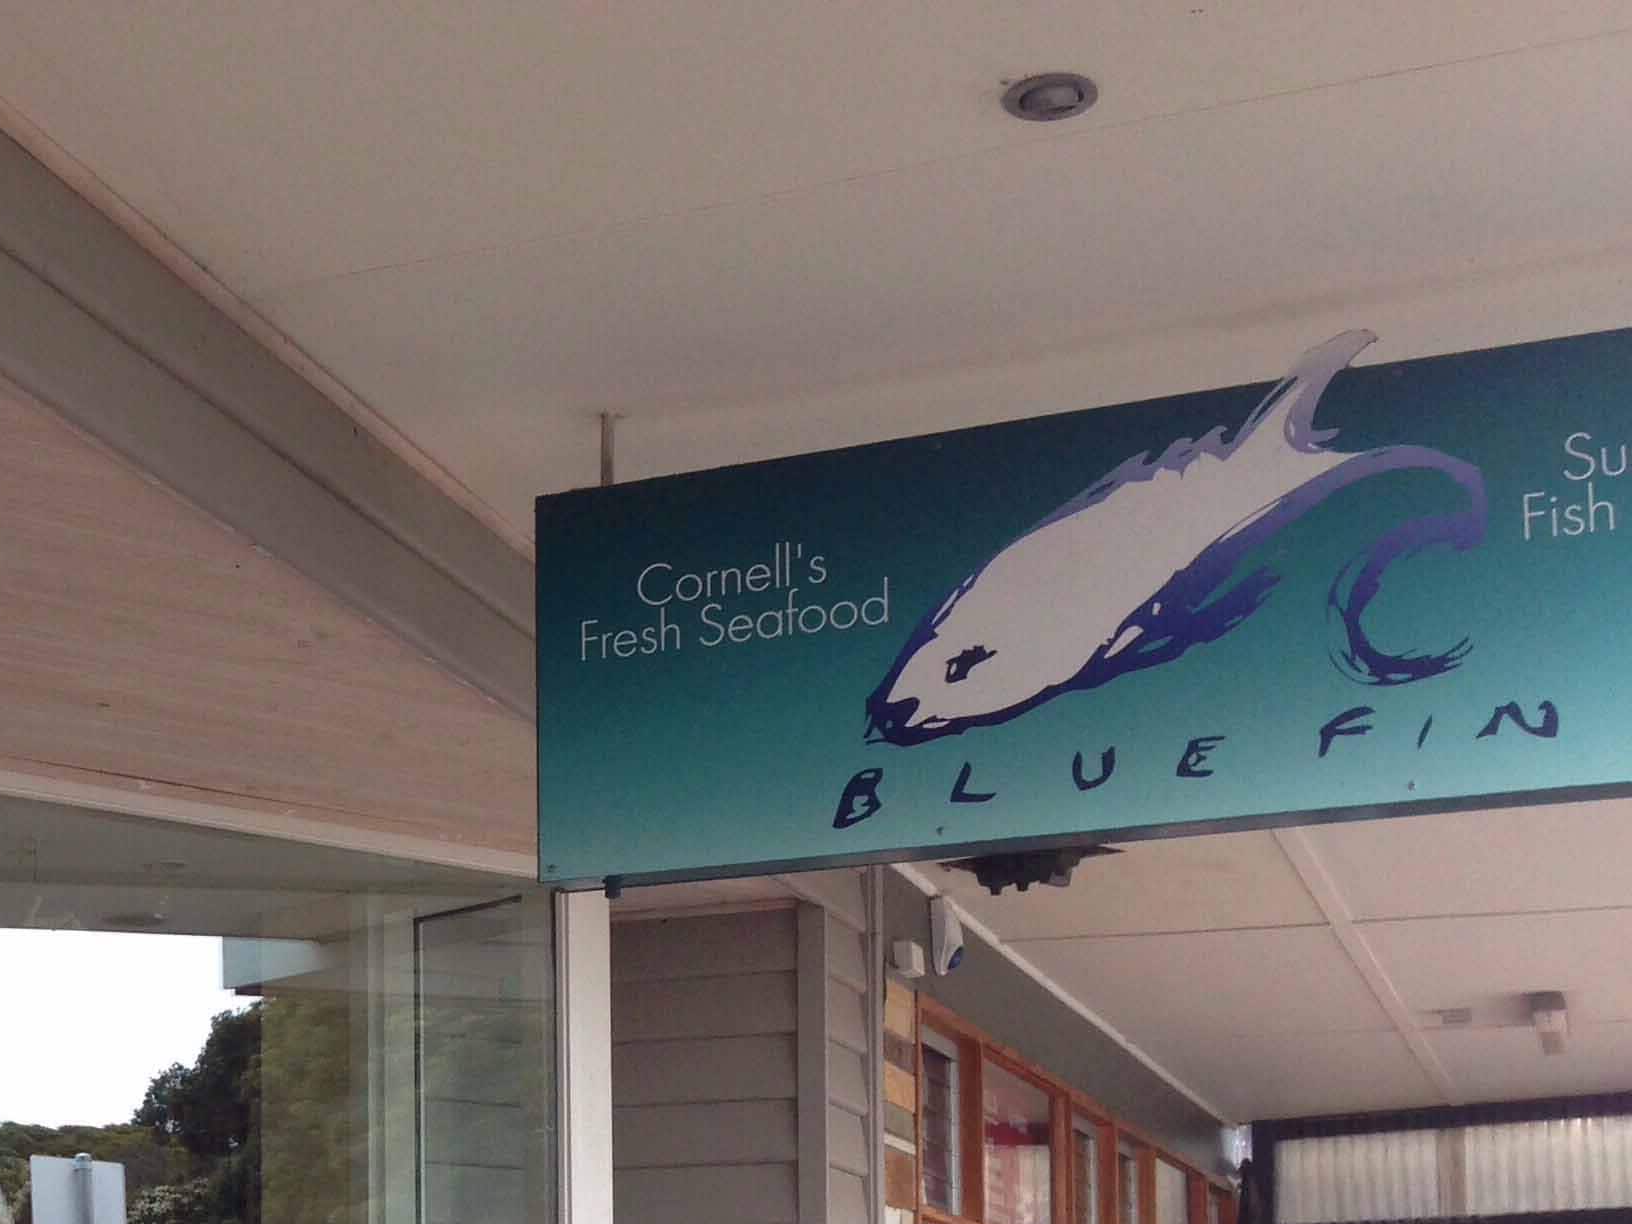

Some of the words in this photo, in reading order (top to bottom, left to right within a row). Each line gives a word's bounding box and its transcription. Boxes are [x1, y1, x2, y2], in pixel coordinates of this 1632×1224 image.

[1522, 481, 1615, 540] Fish
[637, 541, 827, 605] Cornell's
[580, 606, 681, 661] Fresh
[699, 576, 889, 646] Seafood
